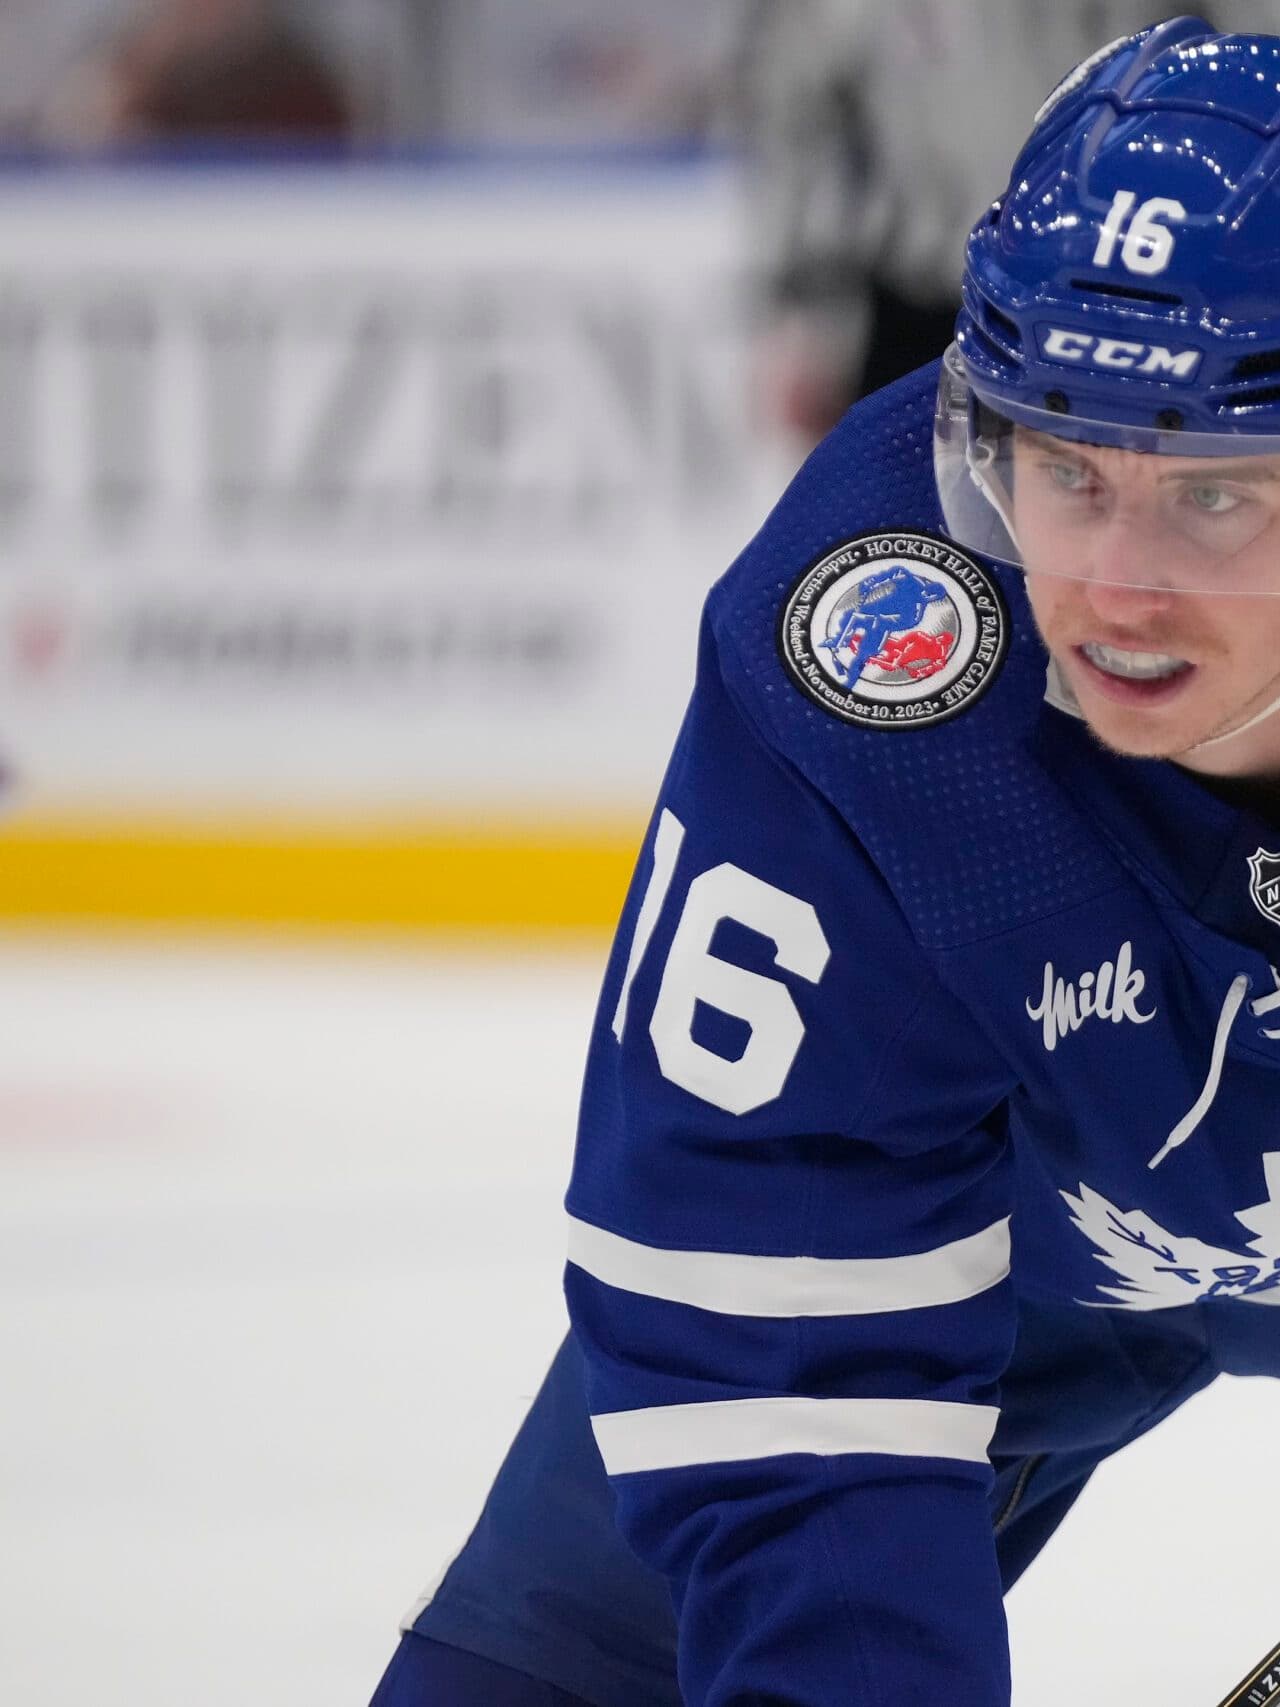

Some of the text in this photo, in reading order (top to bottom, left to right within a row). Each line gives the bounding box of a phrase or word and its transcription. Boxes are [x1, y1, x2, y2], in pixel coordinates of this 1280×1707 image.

[1092, 190, 1186, 276] 16
[1043, 328, 1200, 378] CCM
[864, 538, 946, 562] HOCKEY
[943, 553, 984, 594] HALL
[799, 550, 857, 602] Induction
[789, 604, 812, 661] Weekend
[975, 615, 997, 662] FAME
[941, 662, 985, 705] GAME
[1026, 941, 1157, 1051] Milk
[1262, 1673, 1279, 1693] Z
